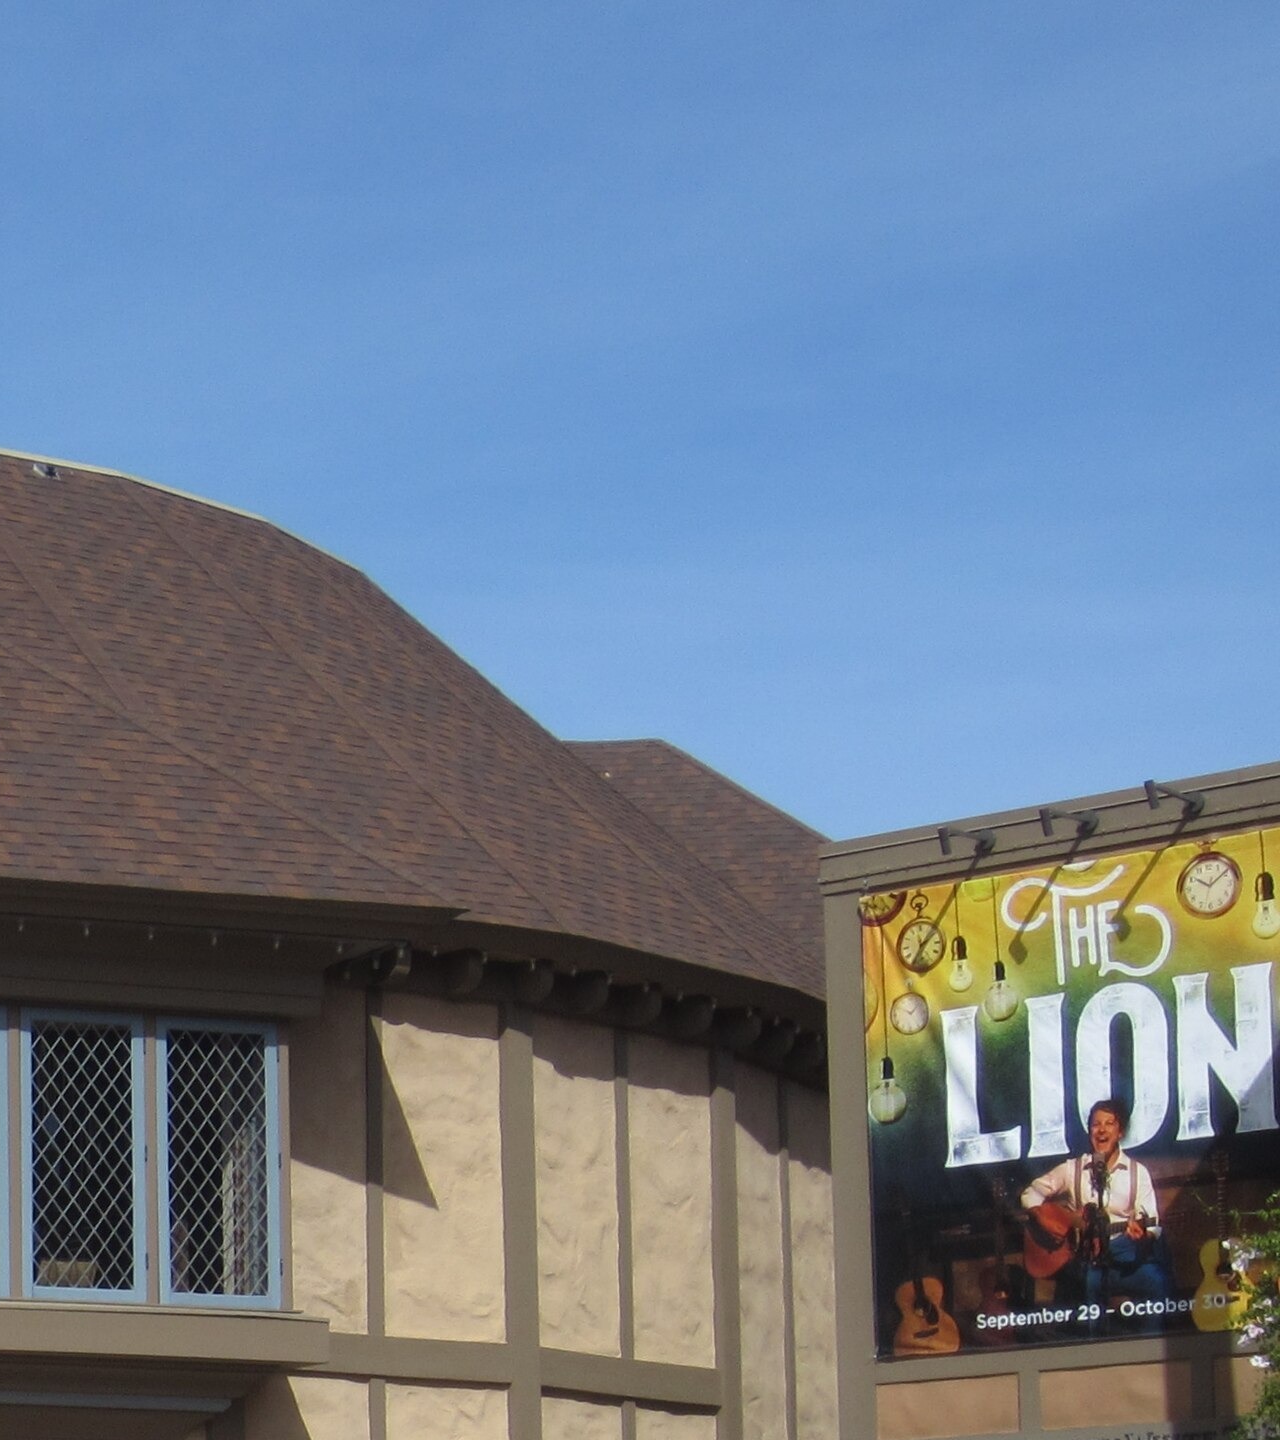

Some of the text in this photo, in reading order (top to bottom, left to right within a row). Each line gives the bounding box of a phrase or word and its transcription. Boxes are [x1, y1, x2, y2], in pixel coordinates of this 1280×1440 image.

[1000, 863, 1172, 985] THE
[940, 961, 1280, 1168] LION
[976, 1307, 1073, 1330] September
[1077, 1304, 1100, 1320] 29
[1120, 1298, 1195, 1316] October
[1202, 1294, 1226, 1309] 30
